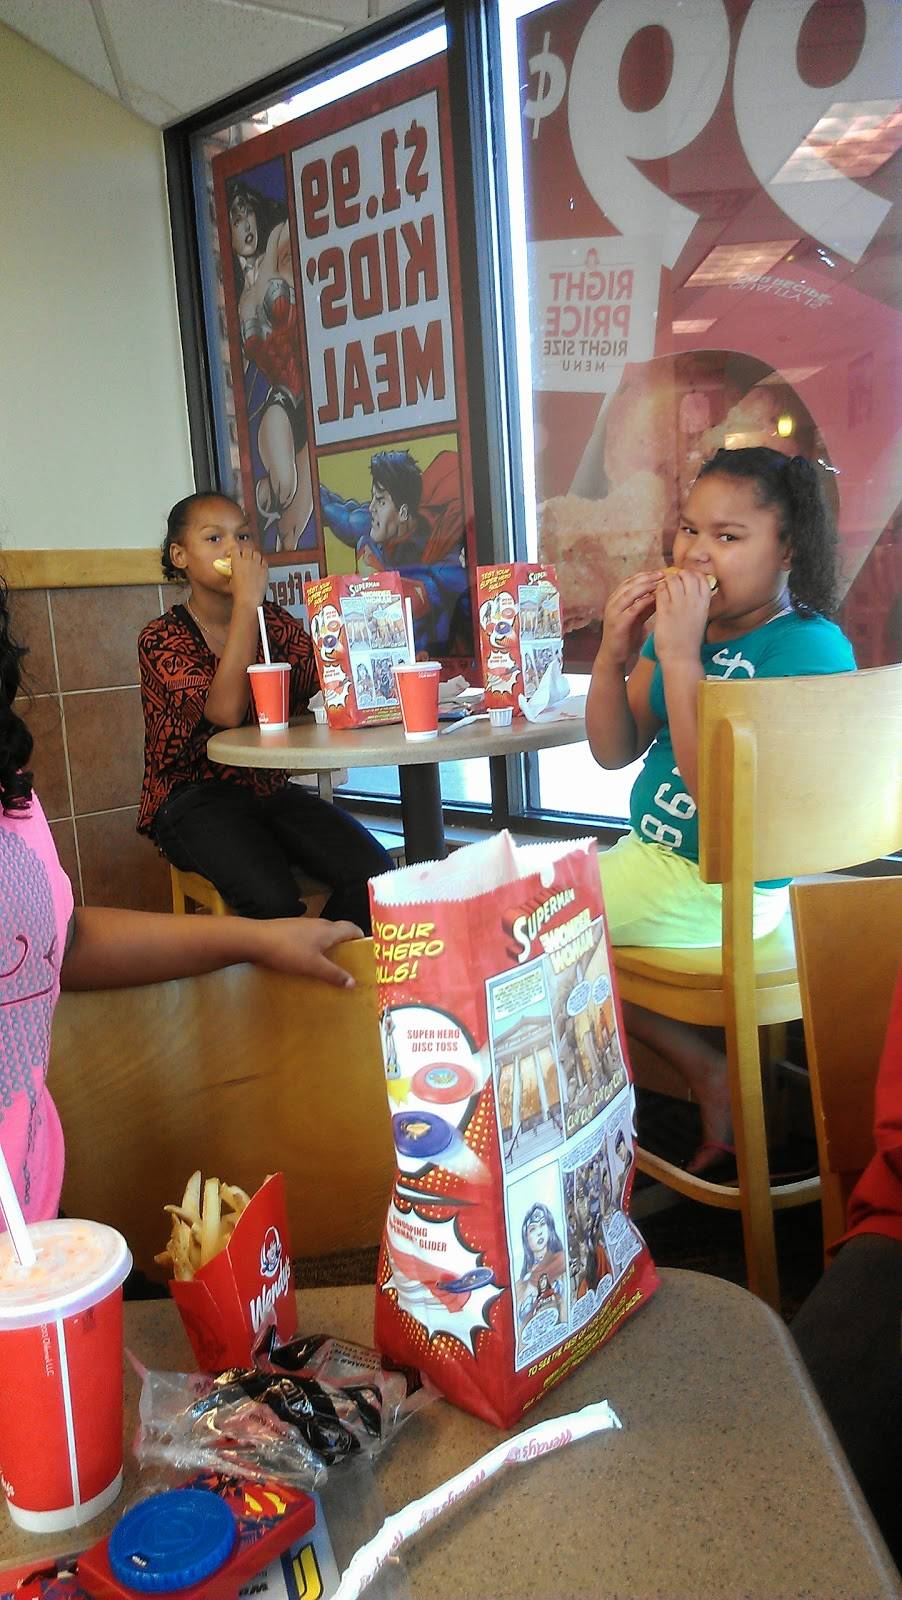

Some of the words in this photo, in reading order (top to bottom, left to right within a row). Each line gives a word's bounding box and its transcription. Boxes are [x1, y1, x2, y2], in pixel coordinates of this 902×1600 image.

[349, 581, 380, 597] SUPERMAN
[375, 921, 435, 941] YOUR
[512, 887, 576, 964] SUPERMAN
[382, 940, 444, 962] HERO
[407, 1029, 434, 1040] SUPER
[437, 1029, 460, 1040] HERO
[411, 1041, 433, 1052] DISC
[436, 1041, 458, 1052] TOSS
[419, 1239, 447, 1252] GLIDER
